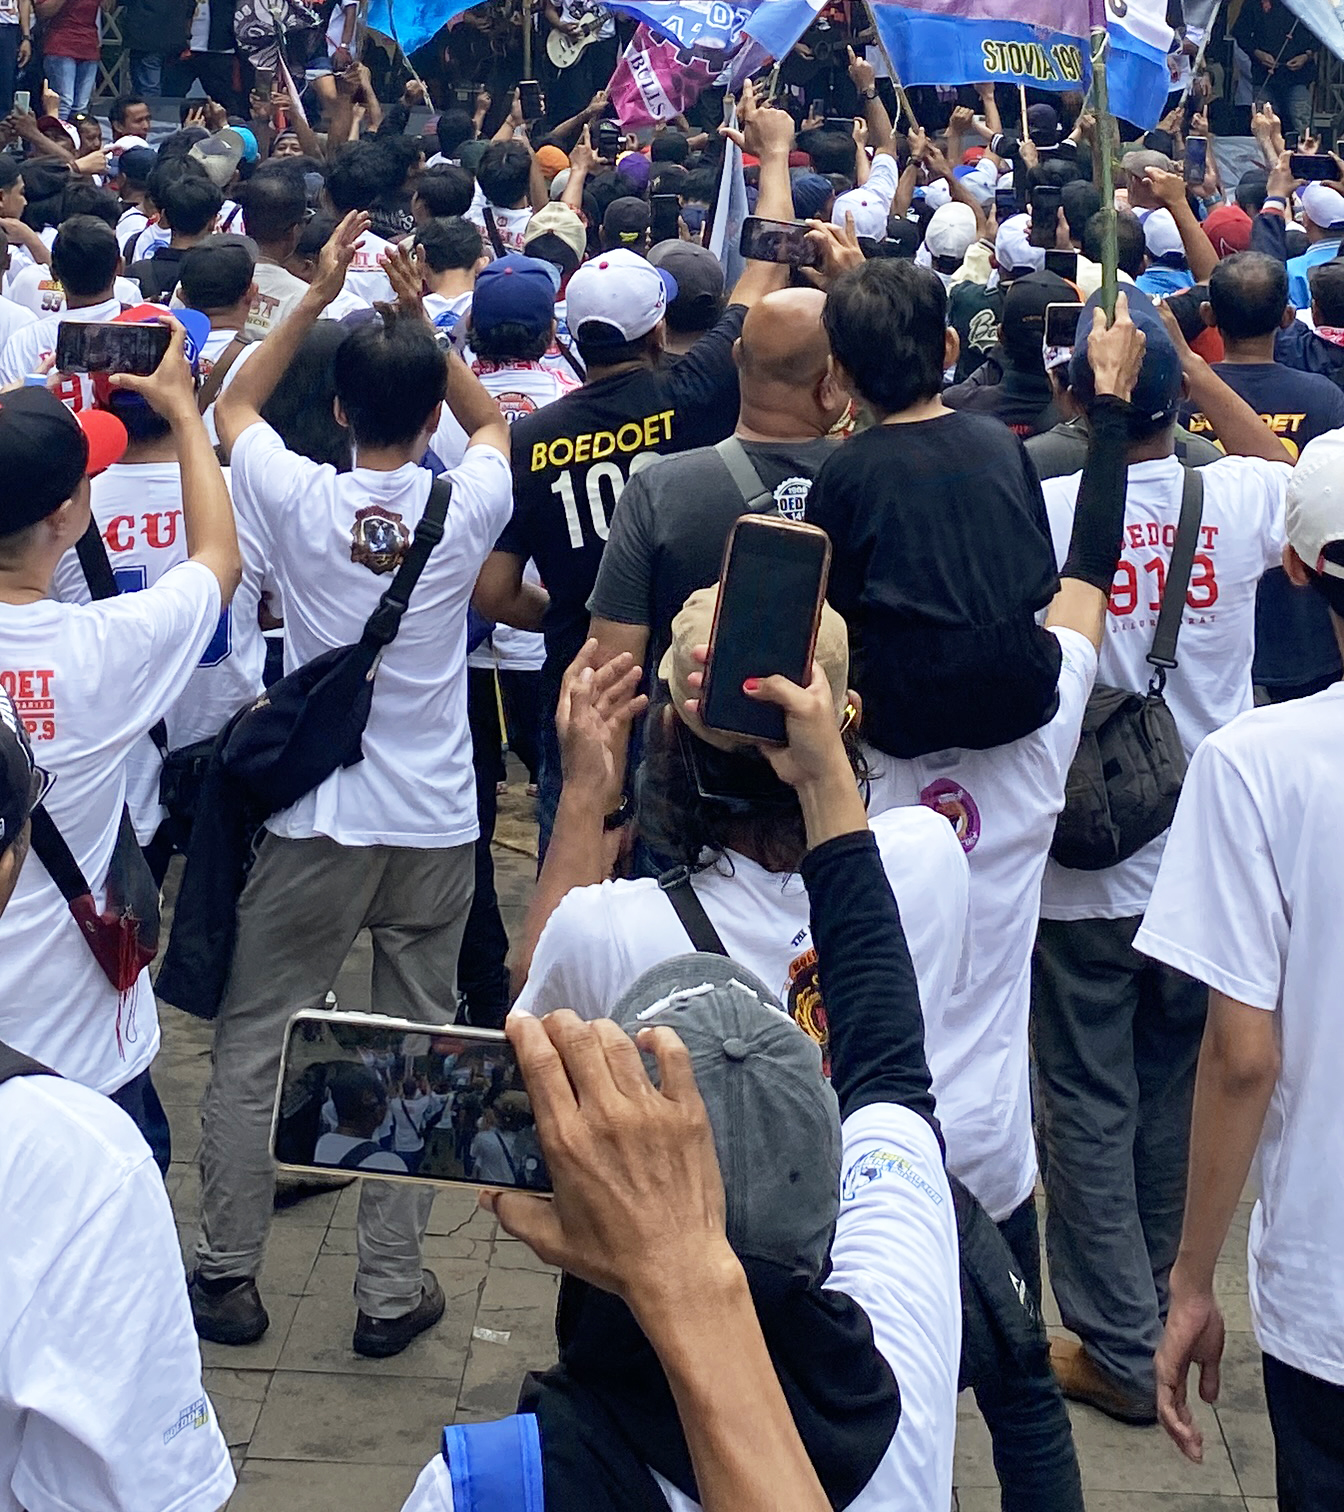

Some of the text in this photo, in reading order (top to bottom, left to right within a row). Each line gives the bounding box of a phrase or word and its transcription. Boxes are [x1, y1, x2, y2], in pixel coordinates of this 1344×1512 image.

[629, 52, 667, 118] BULLS
[981, 38, 1059, 82] STOVIA
[530, 410, 675, 472] BOEDOET
[551, 451, 661, 550] 10
